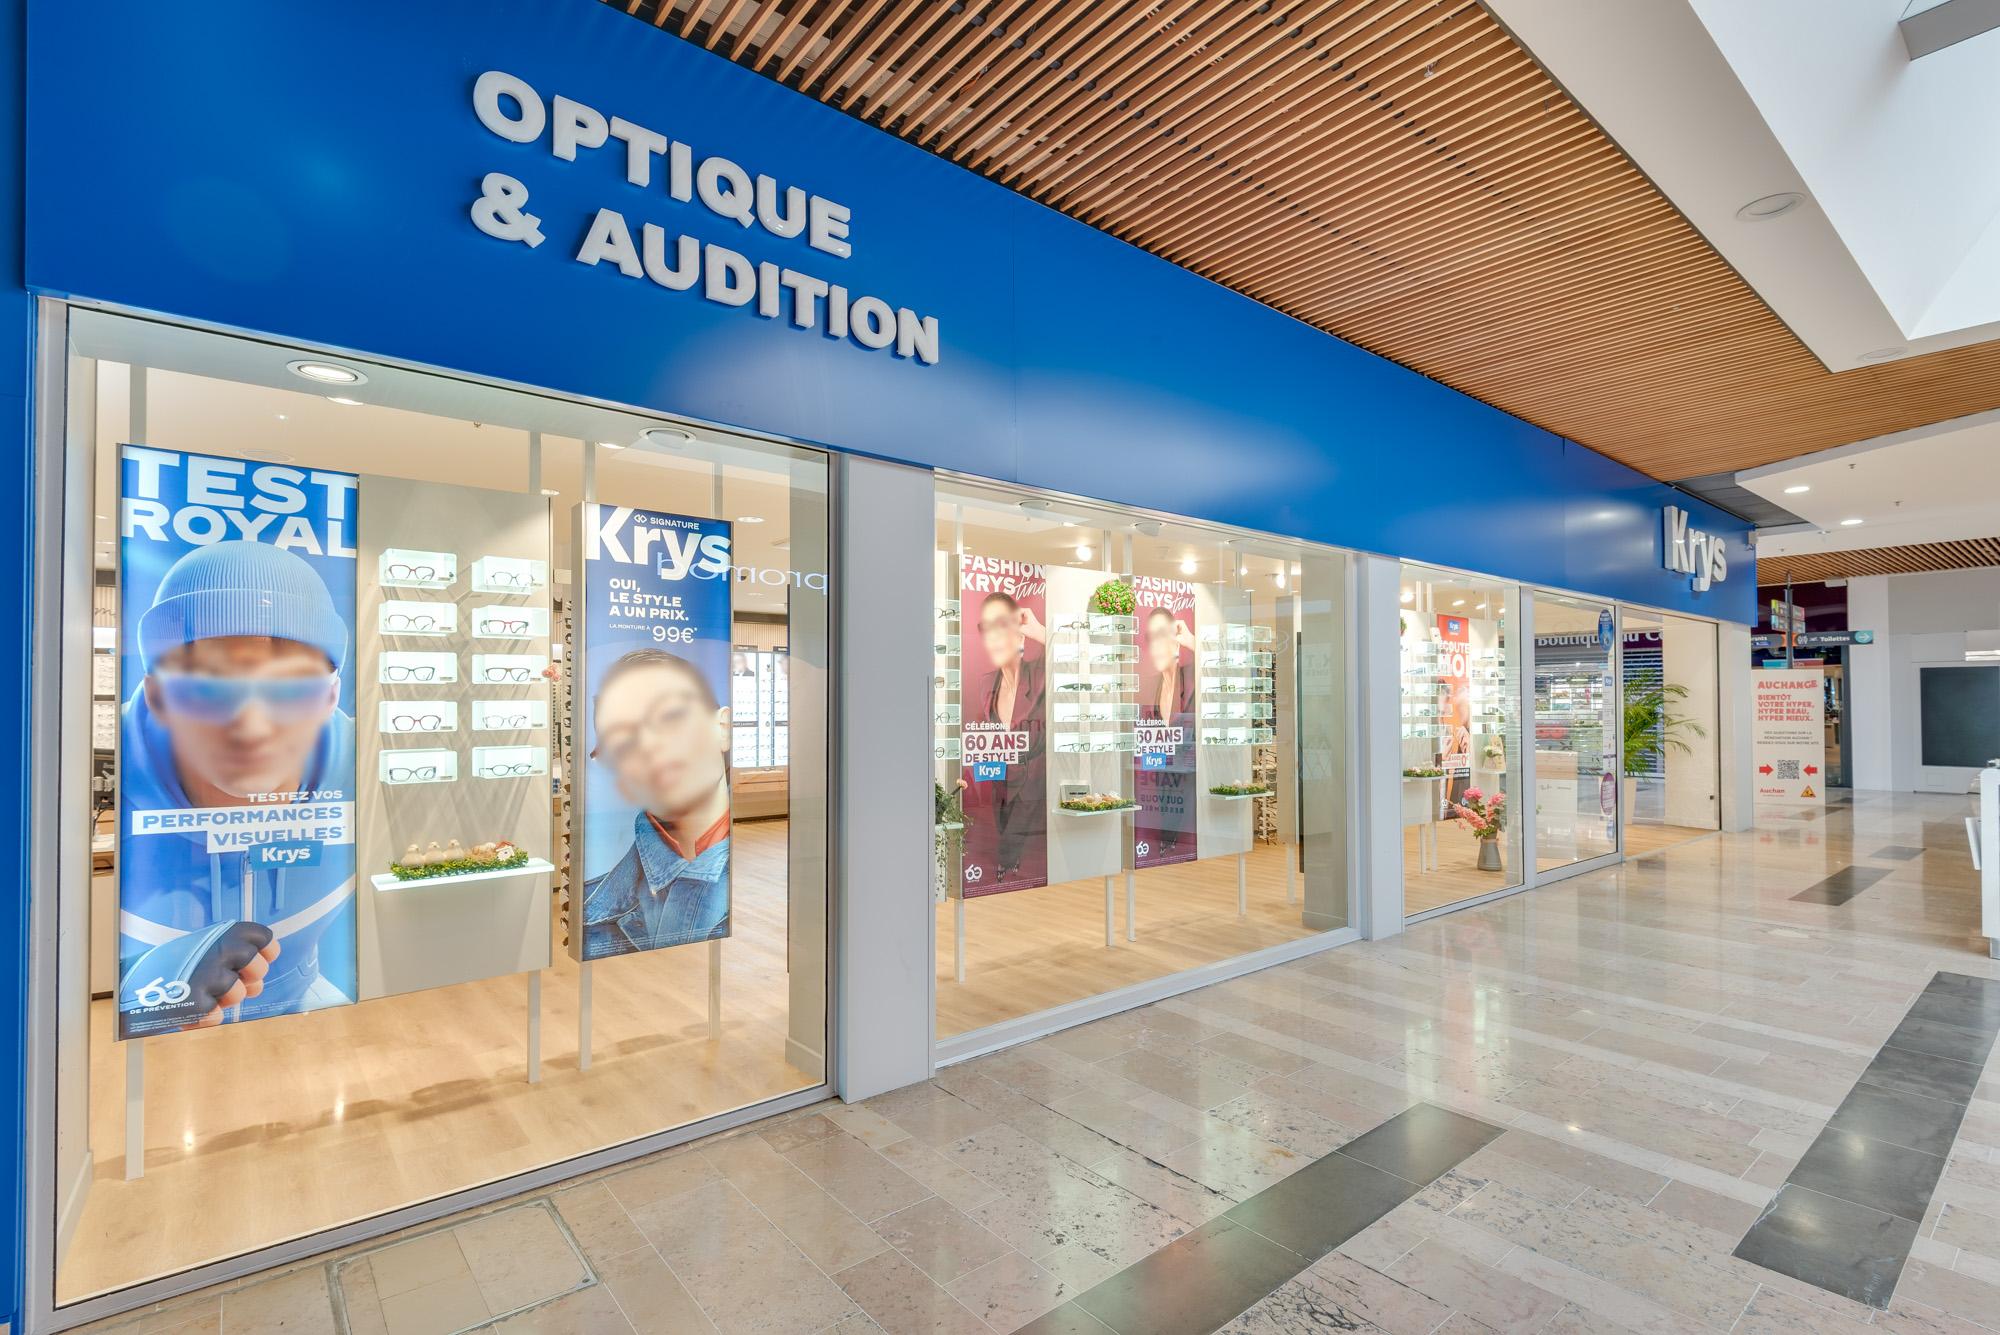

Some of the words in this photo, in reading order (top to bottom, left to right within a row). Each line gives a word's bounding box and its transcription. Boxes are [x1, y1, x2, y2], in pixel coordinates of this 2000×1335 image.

[473, 71, 852, 259] OPTIQUE
[471, 172, 546, 248] &
[576, 207, 939, 364] AUDITION
[122, 445, 358, 520] TEST
[122, 498, 357, 558] ROYAL
[650, 516, 699, 530] SIGNATURE
[586, 503, 732, 581] Krys
[1664, 506, 1727, 592] Krys
[961, 554, 1046, 579] FASHION
[609, 578, 640, 592] OUI,
[1135, 576, 1194, 596] FASHION
[610, 592, 629, 603] LE
[633, 593, 682, 607] STYLE
[609, 605, 621, 616] A
[624, 606, 646, 618] UN
[650, 608, 689, 621] PRIX.
[1758, 680, 1818, 689] AUCHANGE
[965, 721, 1009, 730] CÉLÉBRON
[1136, 718, 1167, 727] CÉLÉBRON
[965, 735, 987, 751] 60
[991, 734, 1027, 750] ANS
[1136, 730, 1152, 743] 60
[1155, 729, 1182, 743] ANS
[1149, 745, 1173, 754] STYLE
[965, 754, 980, 763] DE
[983, 752, 1016, 763] STYLE
[1146, 757, 1163, 766] Krys
[979, 765, 1001, 777] Krys
[247, 791, 309, 803] TESTEZ
[313, 790, 343, 800] VOS
[143, 806, 343, 829] PERFORMANCES
[261, 846, 311, 864] Krys
[143, 1001, 195, 1013] PRÉVENTION
